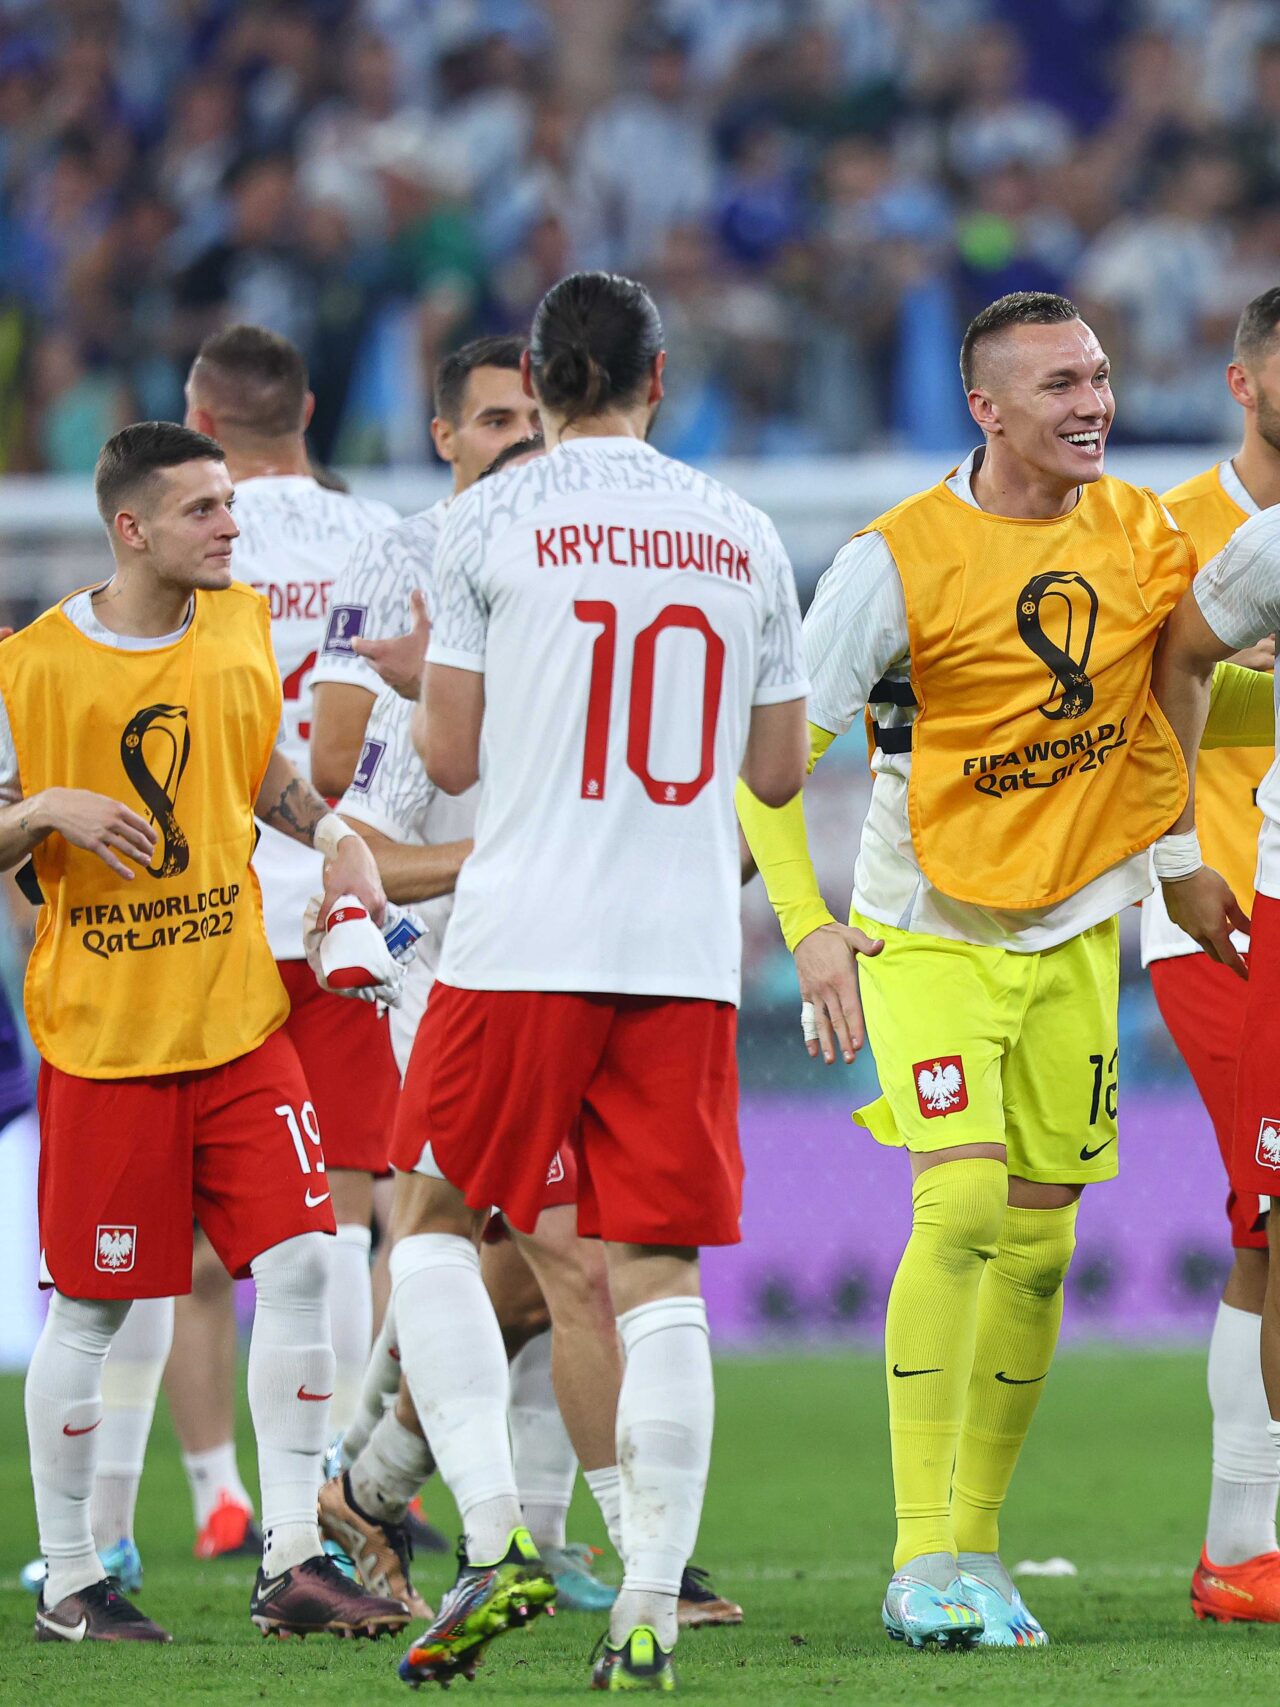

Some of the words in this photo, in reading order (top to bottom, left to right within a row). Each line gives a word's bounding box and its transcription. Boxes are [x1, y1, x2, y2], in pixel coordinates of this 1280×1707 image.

[535, 523, 752, 584] KRYCHOWIAK
[573, 600, 726, 806] 10
[963, 751, 1021, 776] FIFA
[1023, 723, 1116, 763] WORLD
[70, 903, 125, 928] FIFA
[128, 892, 207, 923] WORLD
[208, 883, 240, 908] CUP
[274, 1100, 326, 1174] 19
